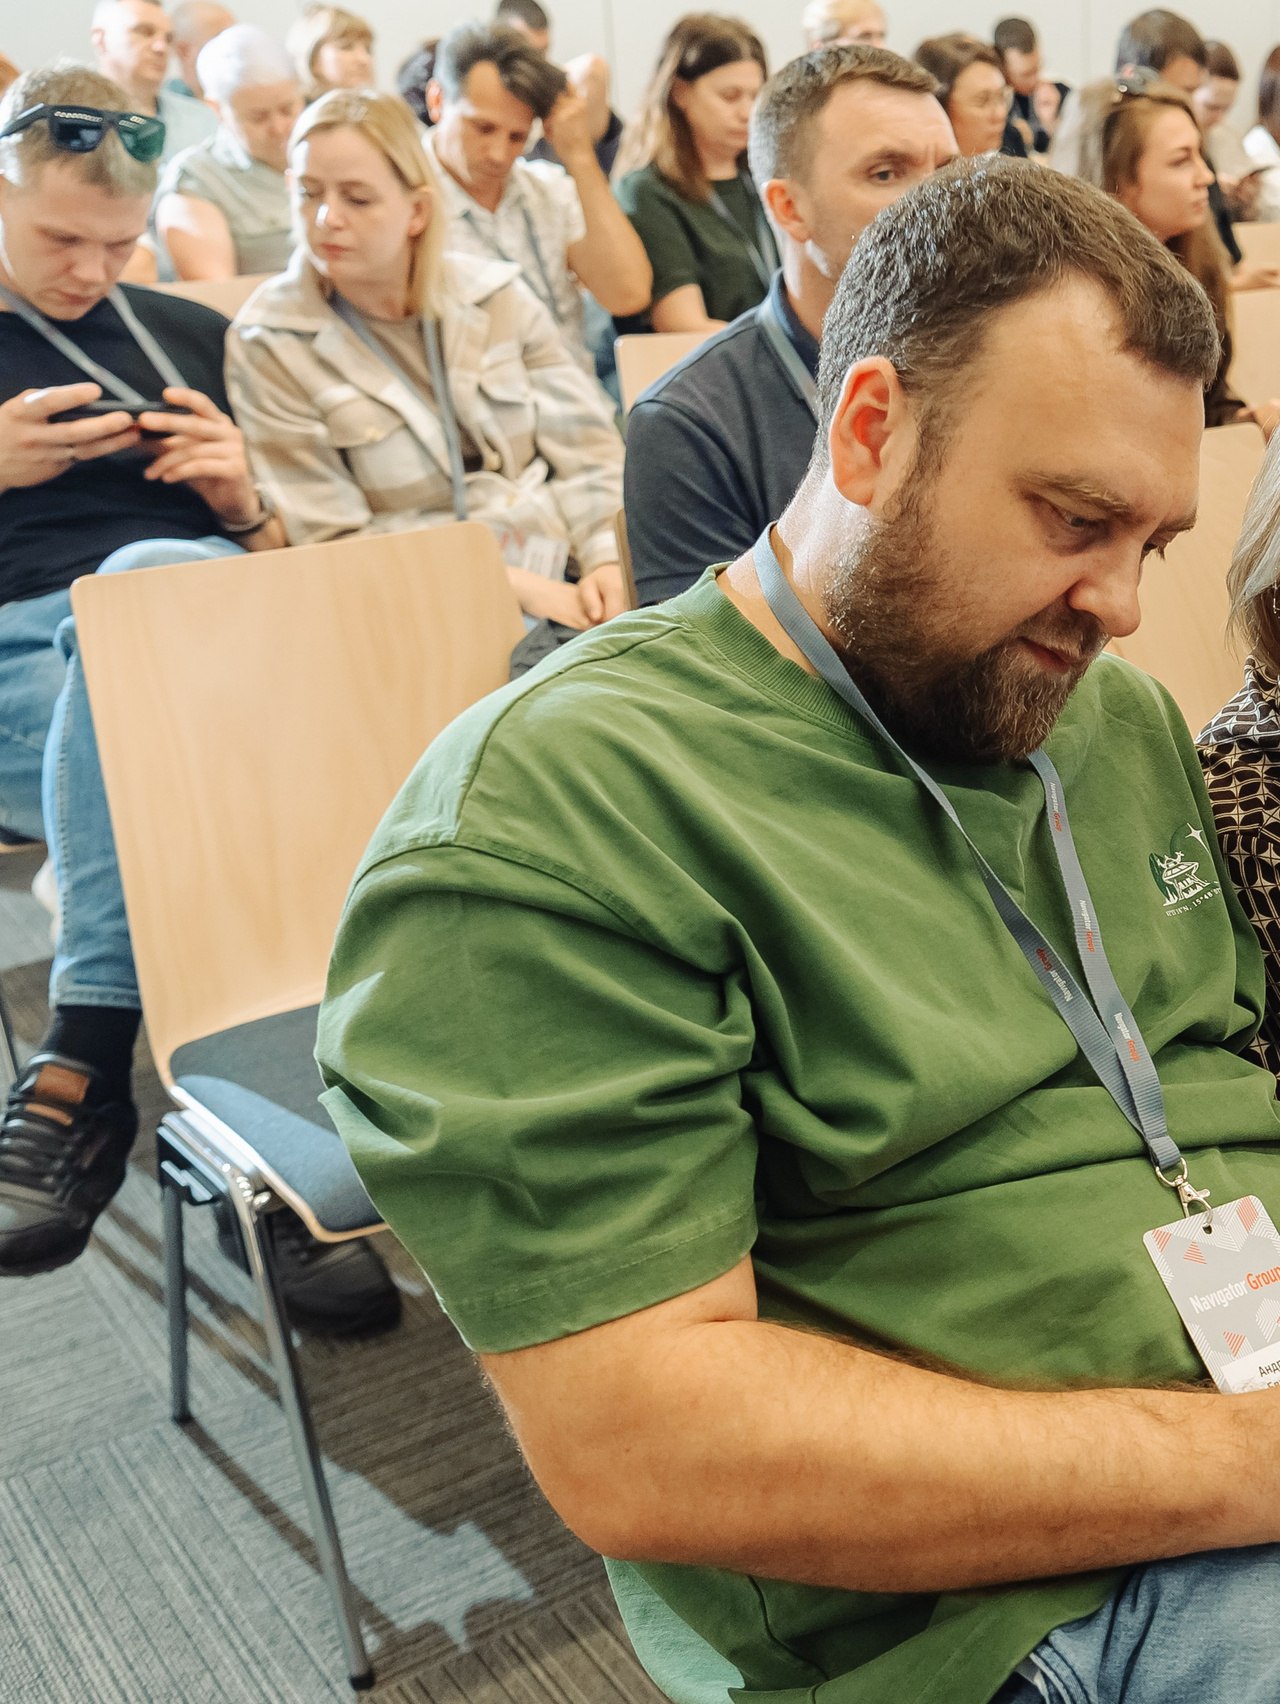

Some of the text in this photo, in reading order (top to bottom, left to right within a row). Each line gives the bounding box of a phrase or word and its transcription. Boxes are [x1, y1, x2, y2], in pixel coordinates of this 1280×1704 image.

[1079, 899, 1095, 952] Navigator Group
[1036, 949, 1074, 1002] Navigator Group
[1127, 1040, 1140, 1061] Group
[1189, 1280, 1249, 1315] Navigator
